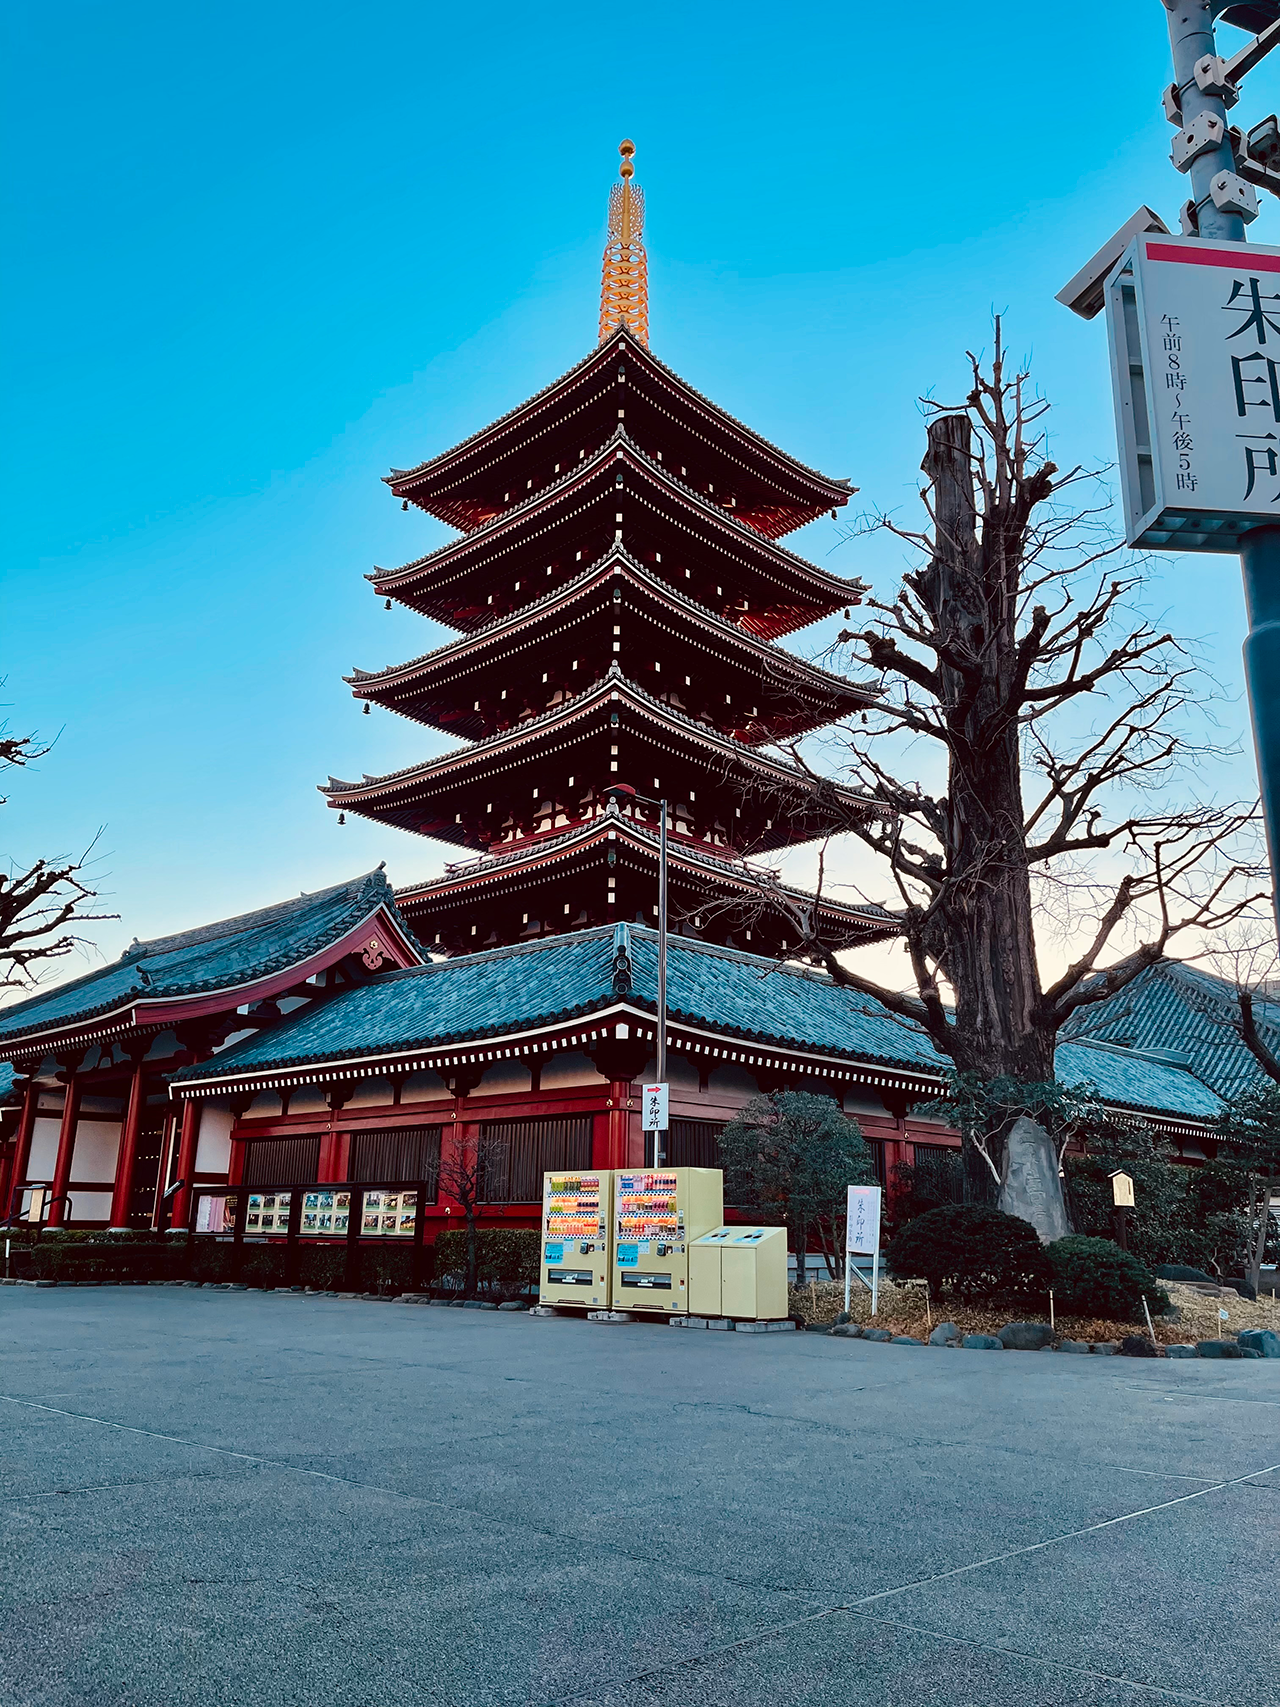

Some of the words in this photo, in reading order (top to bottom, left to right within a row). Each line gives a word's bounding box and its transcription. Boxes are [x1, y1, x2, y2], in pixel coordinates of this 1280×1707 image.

[649, 1095, 661, 1128] 朱印所
[855, 1198, 866, 1247] 朱印所
